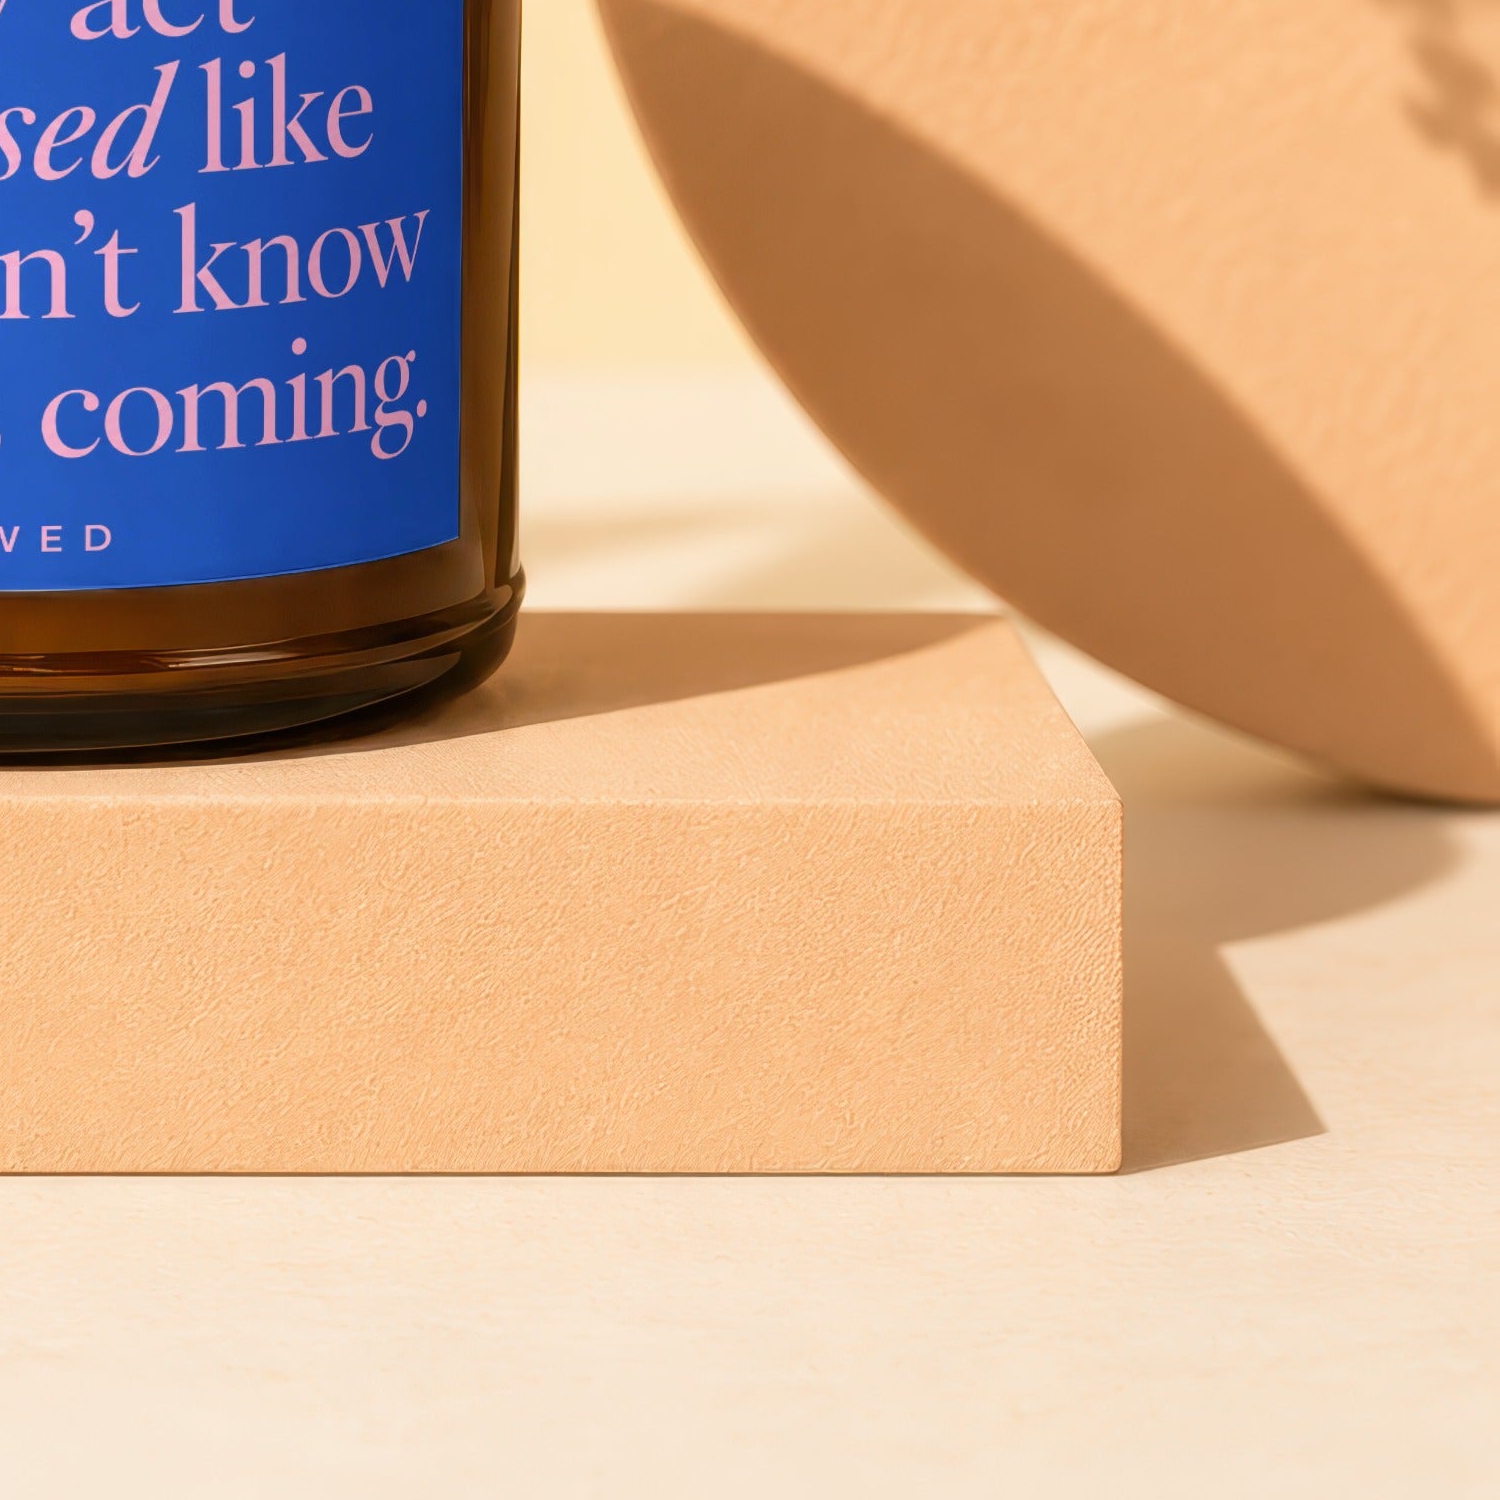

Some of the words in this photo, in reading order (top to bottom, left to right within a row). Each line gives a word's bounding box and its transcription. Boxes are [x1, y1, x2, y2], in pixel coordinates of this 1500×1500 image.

[198, 52, 373, 173] like
[173, 202, 429, 314] know
[41, 337, 427, 460] coming.
